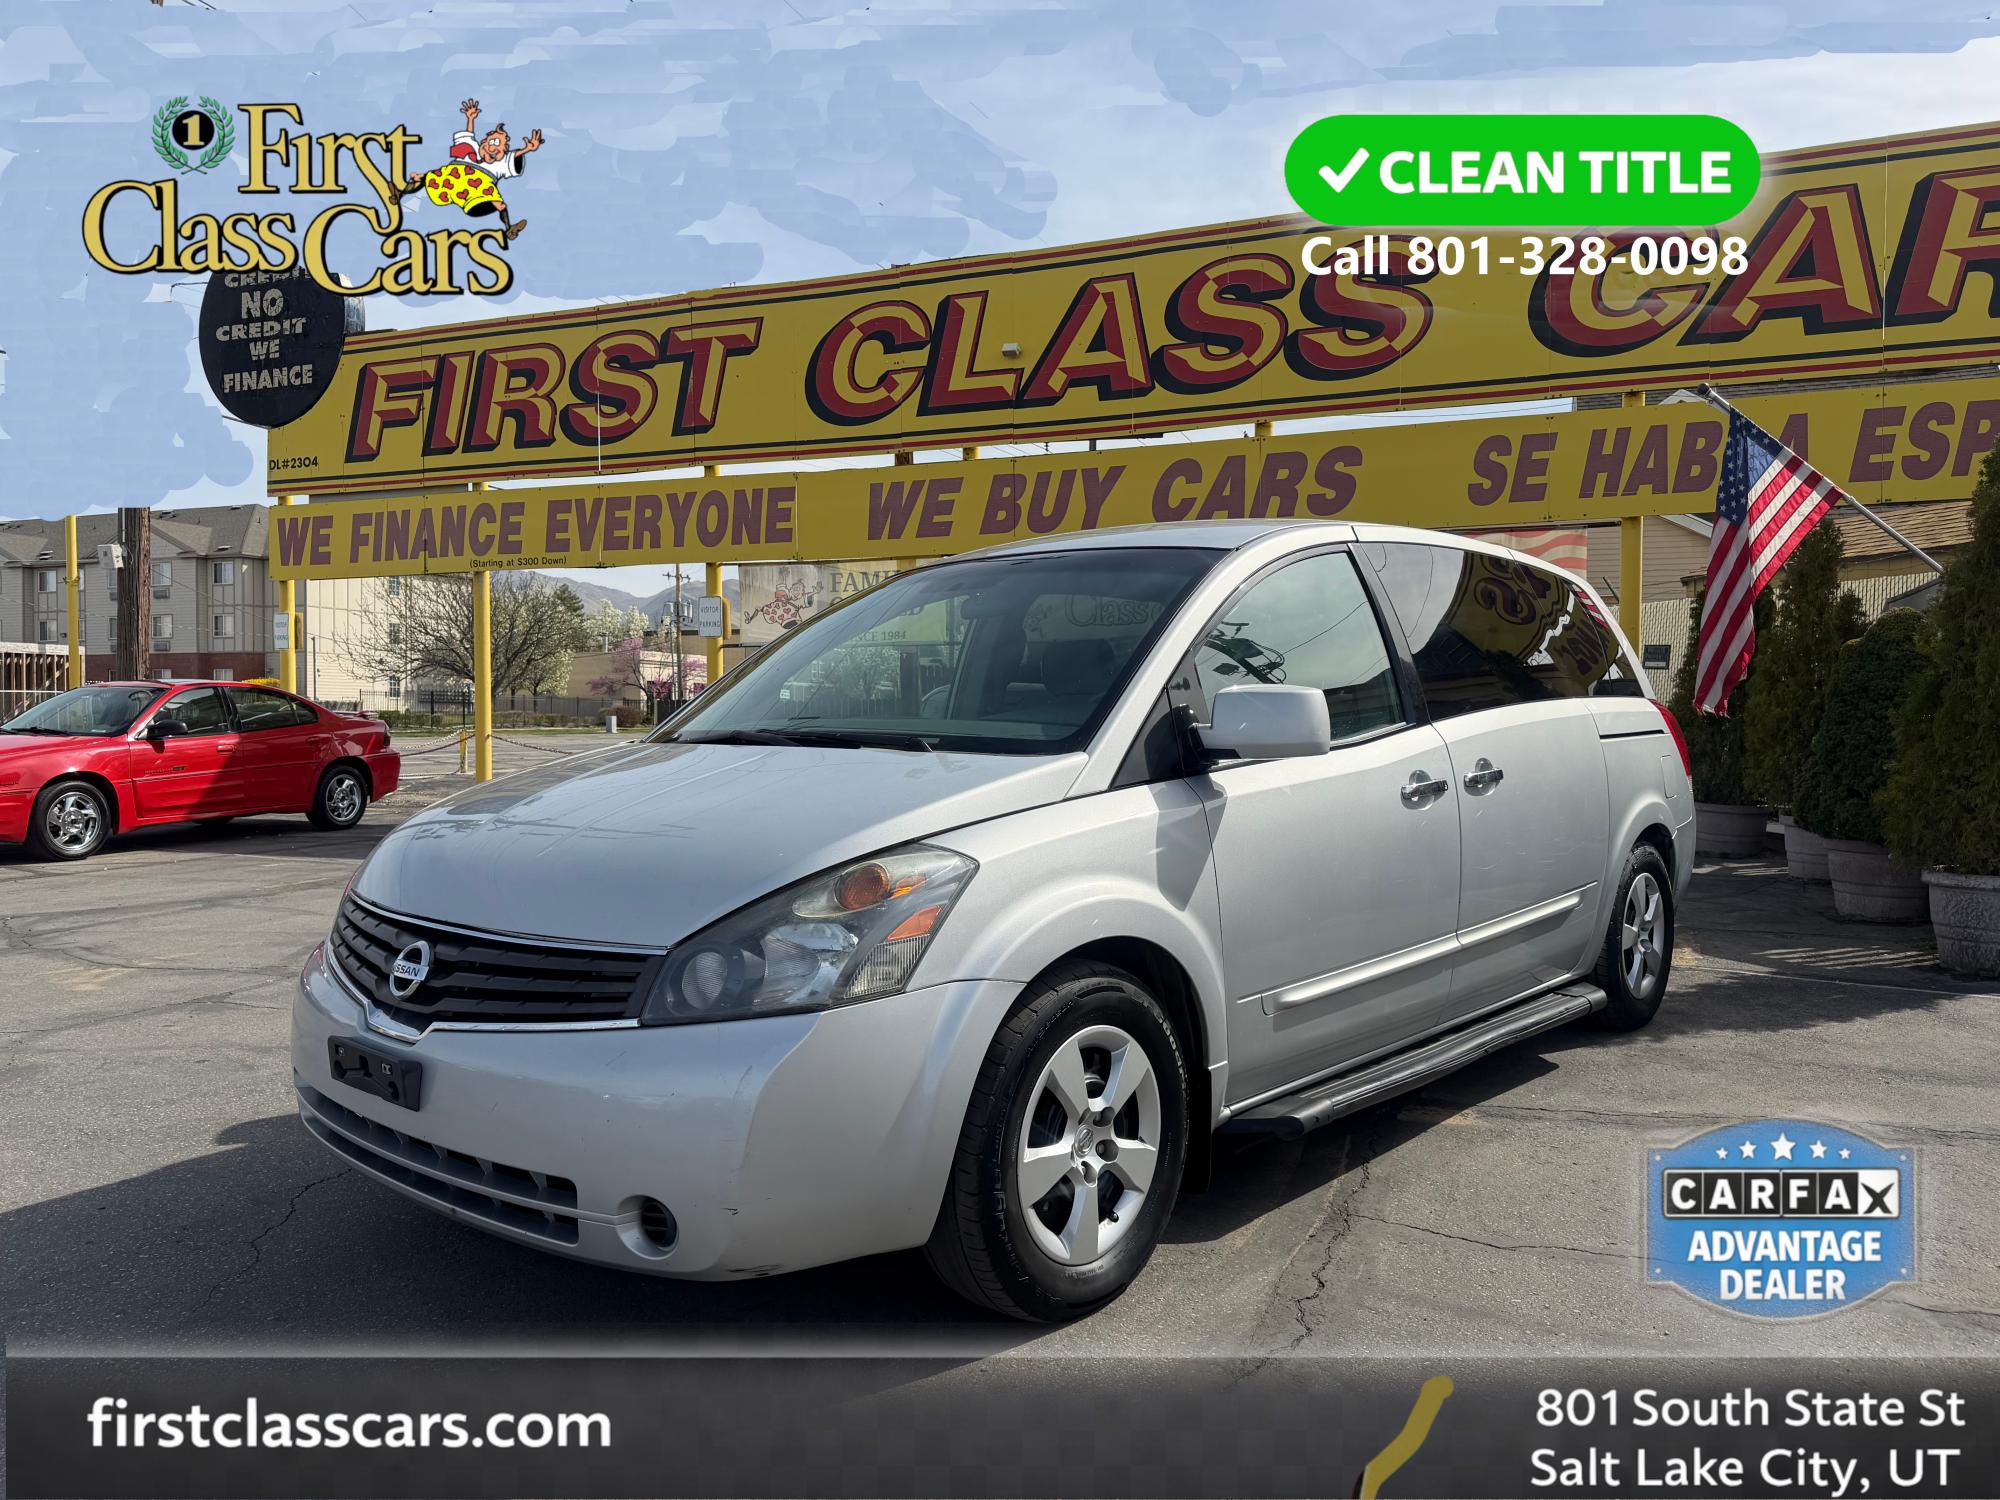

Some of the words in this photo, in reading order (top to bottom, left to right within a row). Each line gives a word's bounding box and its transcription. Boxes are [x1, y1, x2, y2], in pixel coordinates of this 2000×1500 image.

[241, 288, 284, 319] NO
[215, 317, 307, 342] CREDIT
[249, 339, 280, 361] WE
[345, 317, 763, 463] FIRST
[805, 233, 1437, 426] CLASS
[223, 364, 313, 393] FINANCE
[269, 456, 319, 470] DL#2304
[1467, 432, 1558, 505] SE
[1579, 413, 1809, 498] HABA
[867, 478, 963, 540] WE
[979, 465, 1126, 535] BUY
[1151, 446, 1363, 523] CARS
[277, 515, 333, 566] WE
[350, 502, 525, 563] FINANCE
[545, 486, 796, 553] EVERYONE
[469, 559, 503, 568] (Starting
[541, 555, 567, 565] Down)
